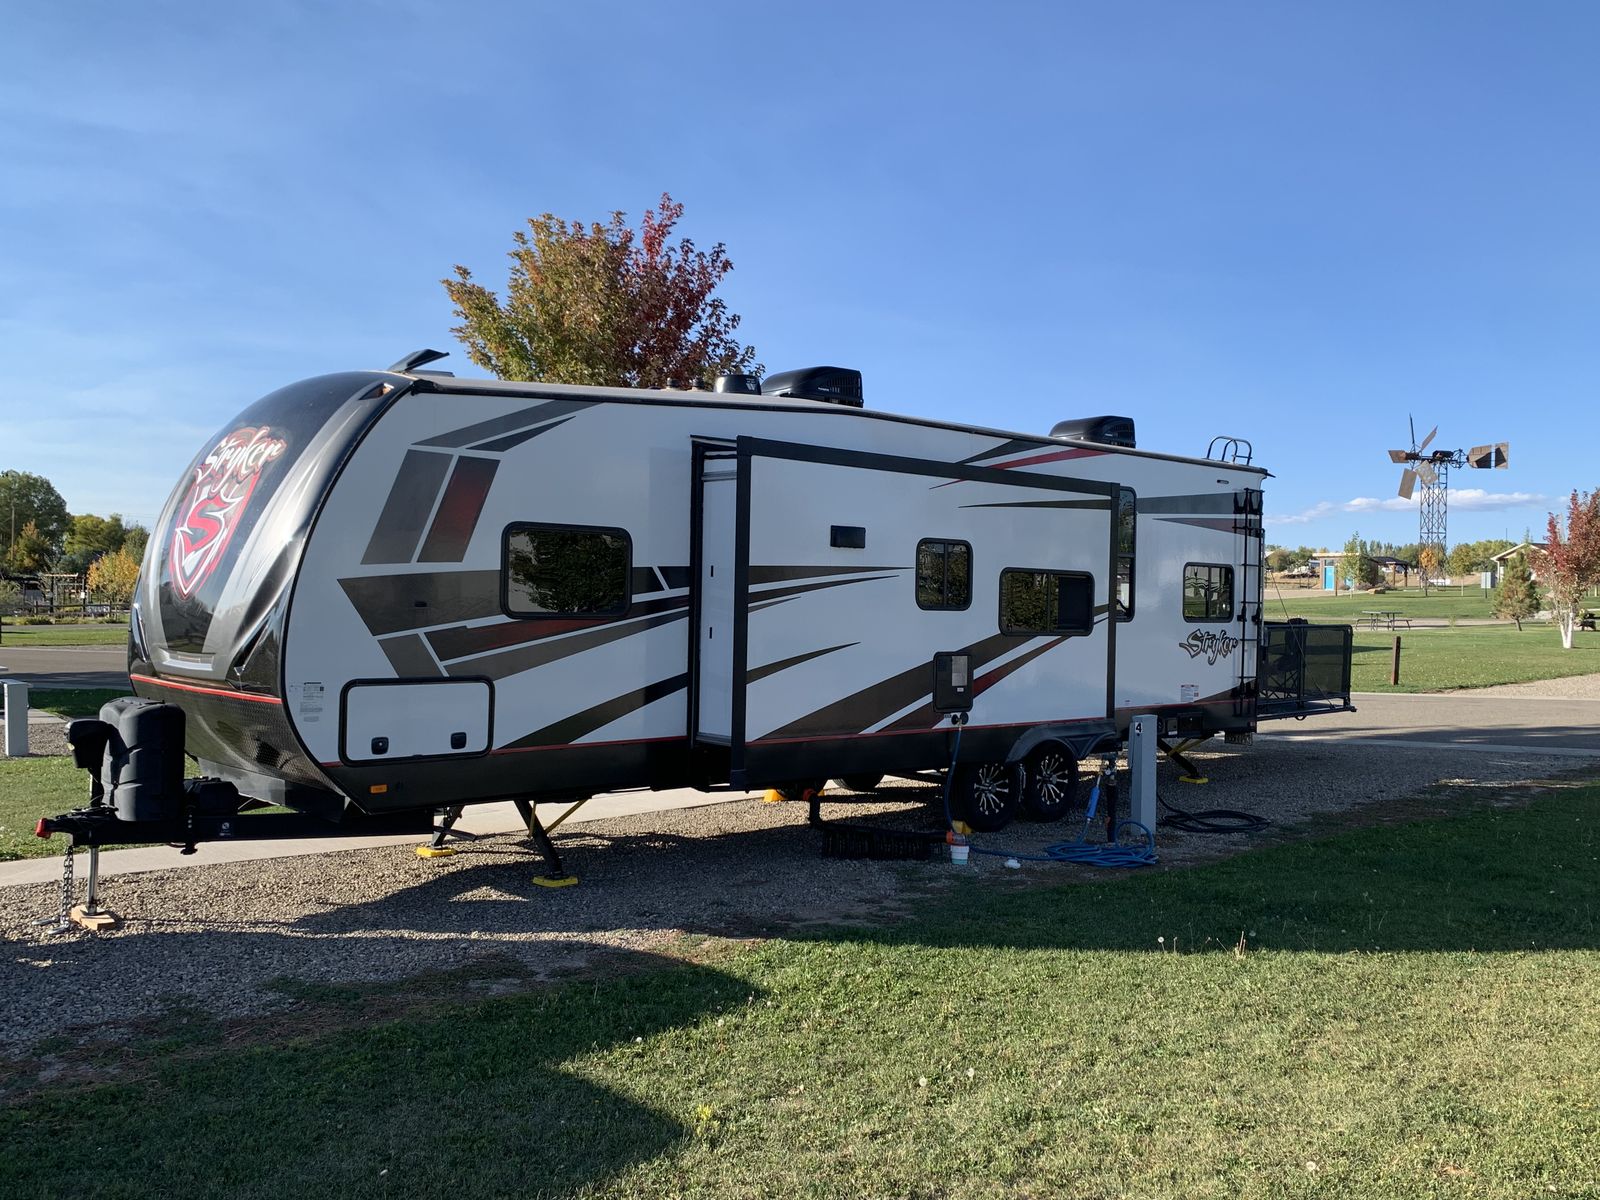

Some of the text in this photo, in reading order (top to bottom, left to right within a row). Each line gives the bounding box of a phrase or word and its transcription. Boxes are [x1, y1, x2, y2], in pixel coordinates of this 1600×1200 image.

[197, 425, 286, 493] Stryker
[1179, 629, 1238, 665] Stryker
[1136, 723, 1142, 733] 4
